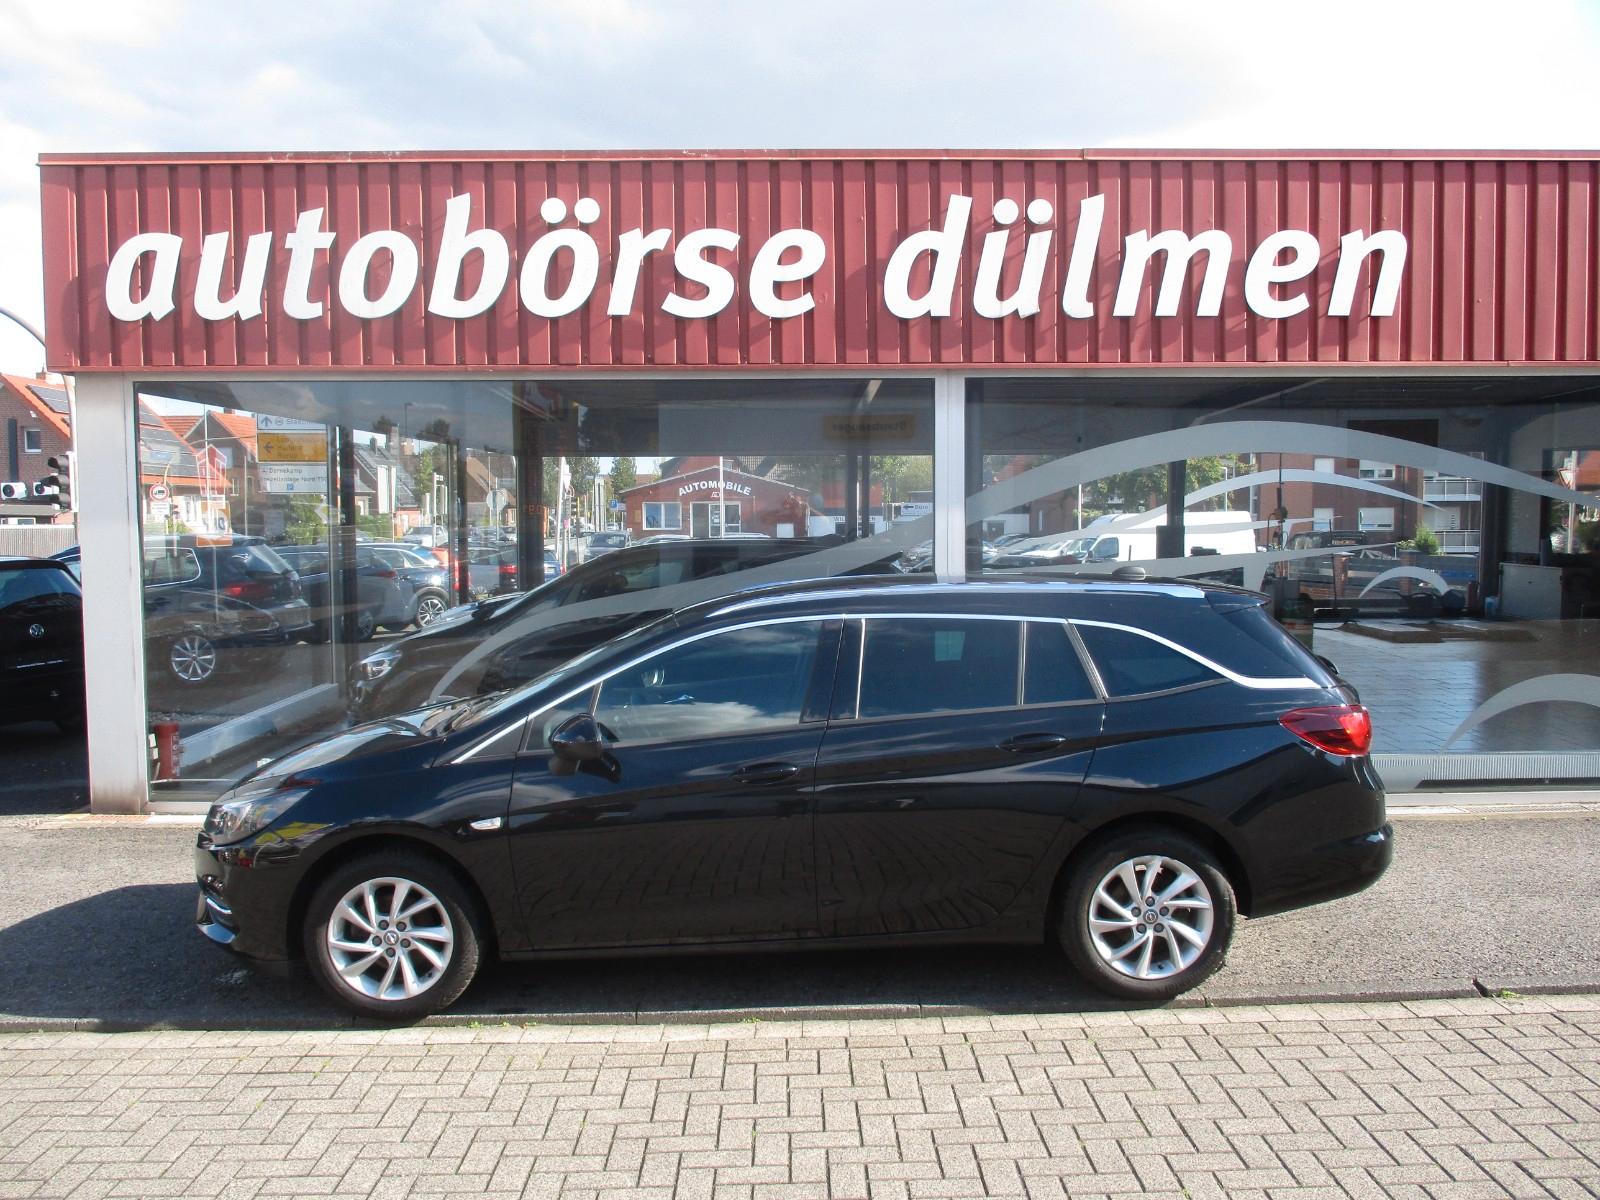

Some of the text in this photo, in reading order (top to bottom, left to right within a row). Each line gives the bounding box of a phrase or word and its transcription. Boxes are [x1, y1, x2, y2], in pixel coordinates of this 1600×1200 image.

[105, 192, 1408, 322] autobörse dülmen
[678, 480, 752, 497] AUTOMOBILE
